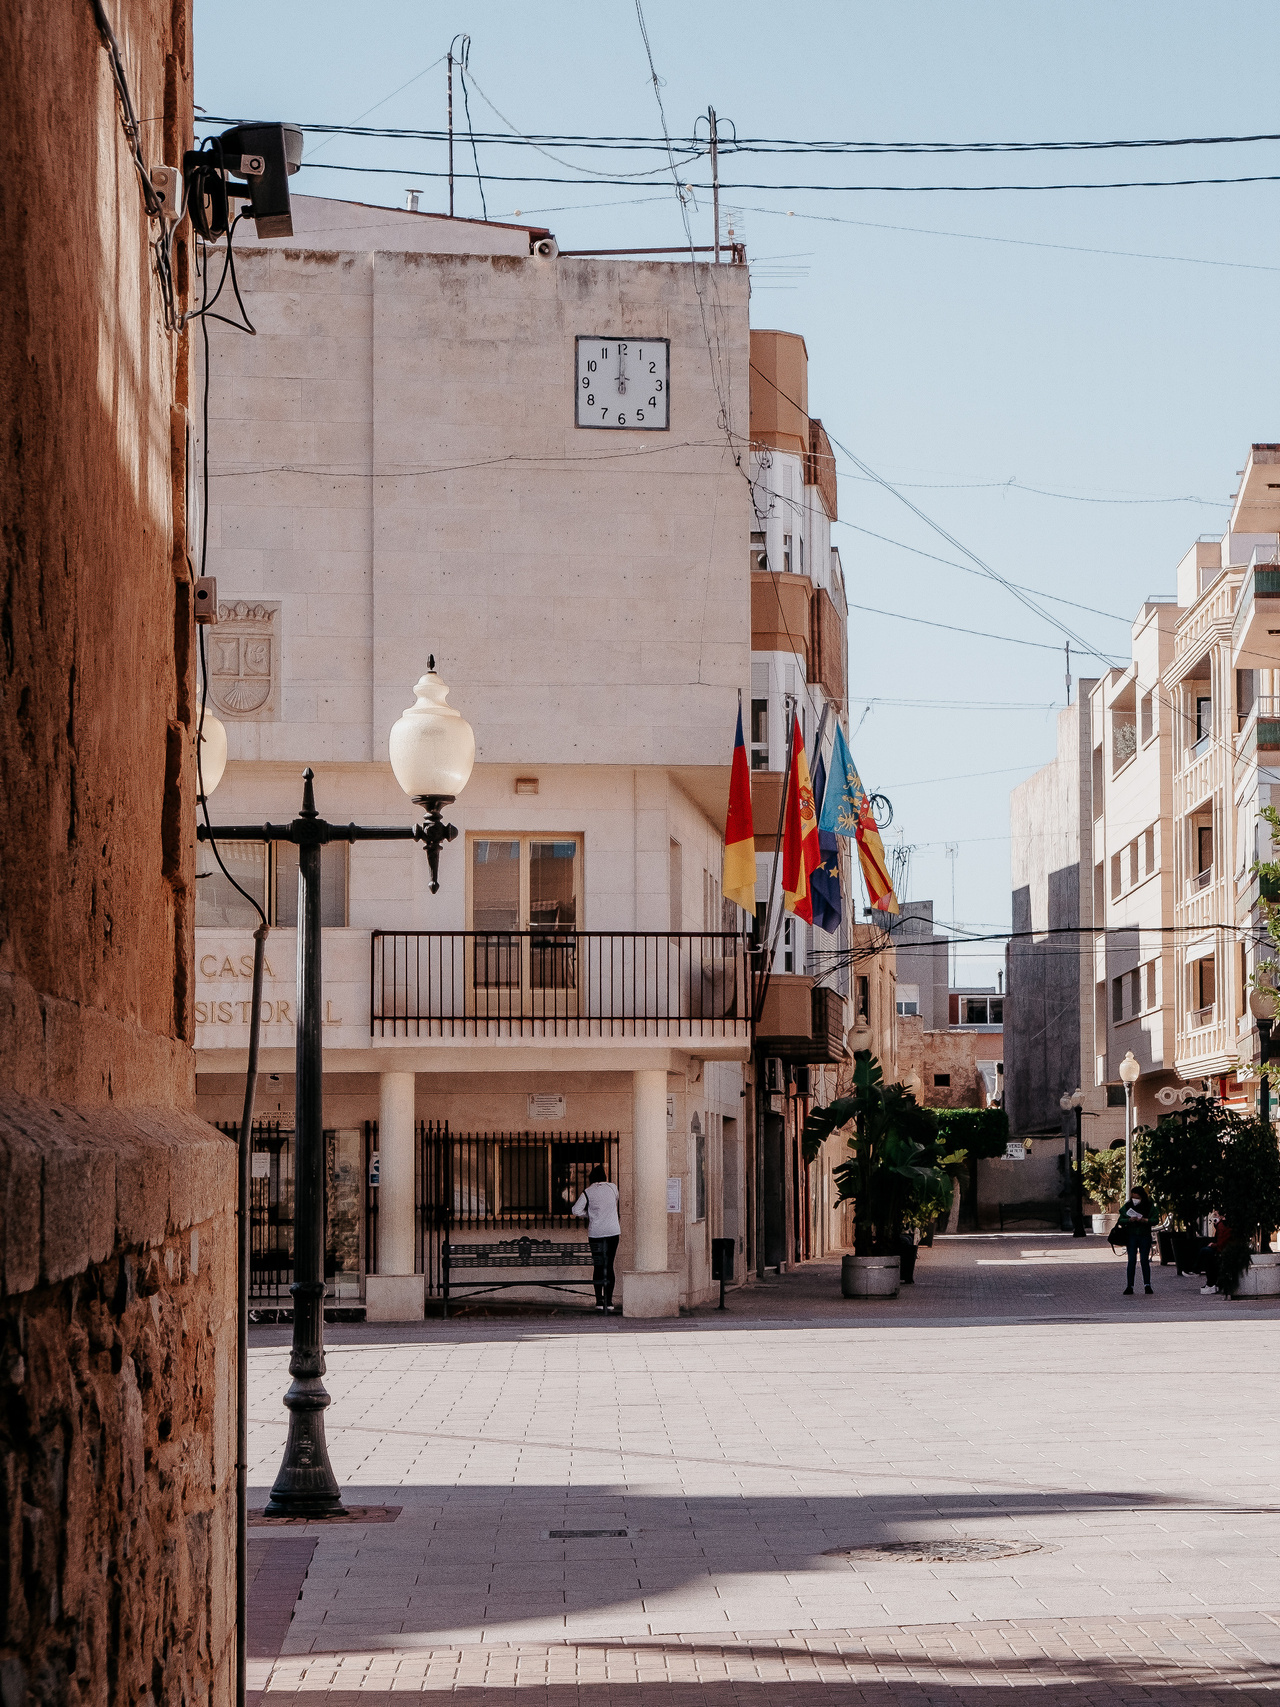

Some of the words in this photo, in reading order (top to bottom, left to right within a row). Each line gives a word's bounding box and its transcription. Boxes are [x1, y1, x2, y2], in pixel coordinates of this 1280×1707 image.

[601, 347, 608, 359] 11
[618, 343, 628, 355] 12
[638, 349, 642, 360] 1
[587, 360, 597, 372] 10
[648, 361, 656, 374] 2
[582, 377, 590, 388] 9
[655, 380, 663, 391] 3
[587, 394, 595, 406] 8
[648, 396, 656, 408] 4
[601, 408, 608, 419] 7
[618, 413, 626, 425] 6
[636, 409, 645, 421] 5
[200, 954, 276, 977] CASA
[195, 1000, 343, 1025] SISTORL
